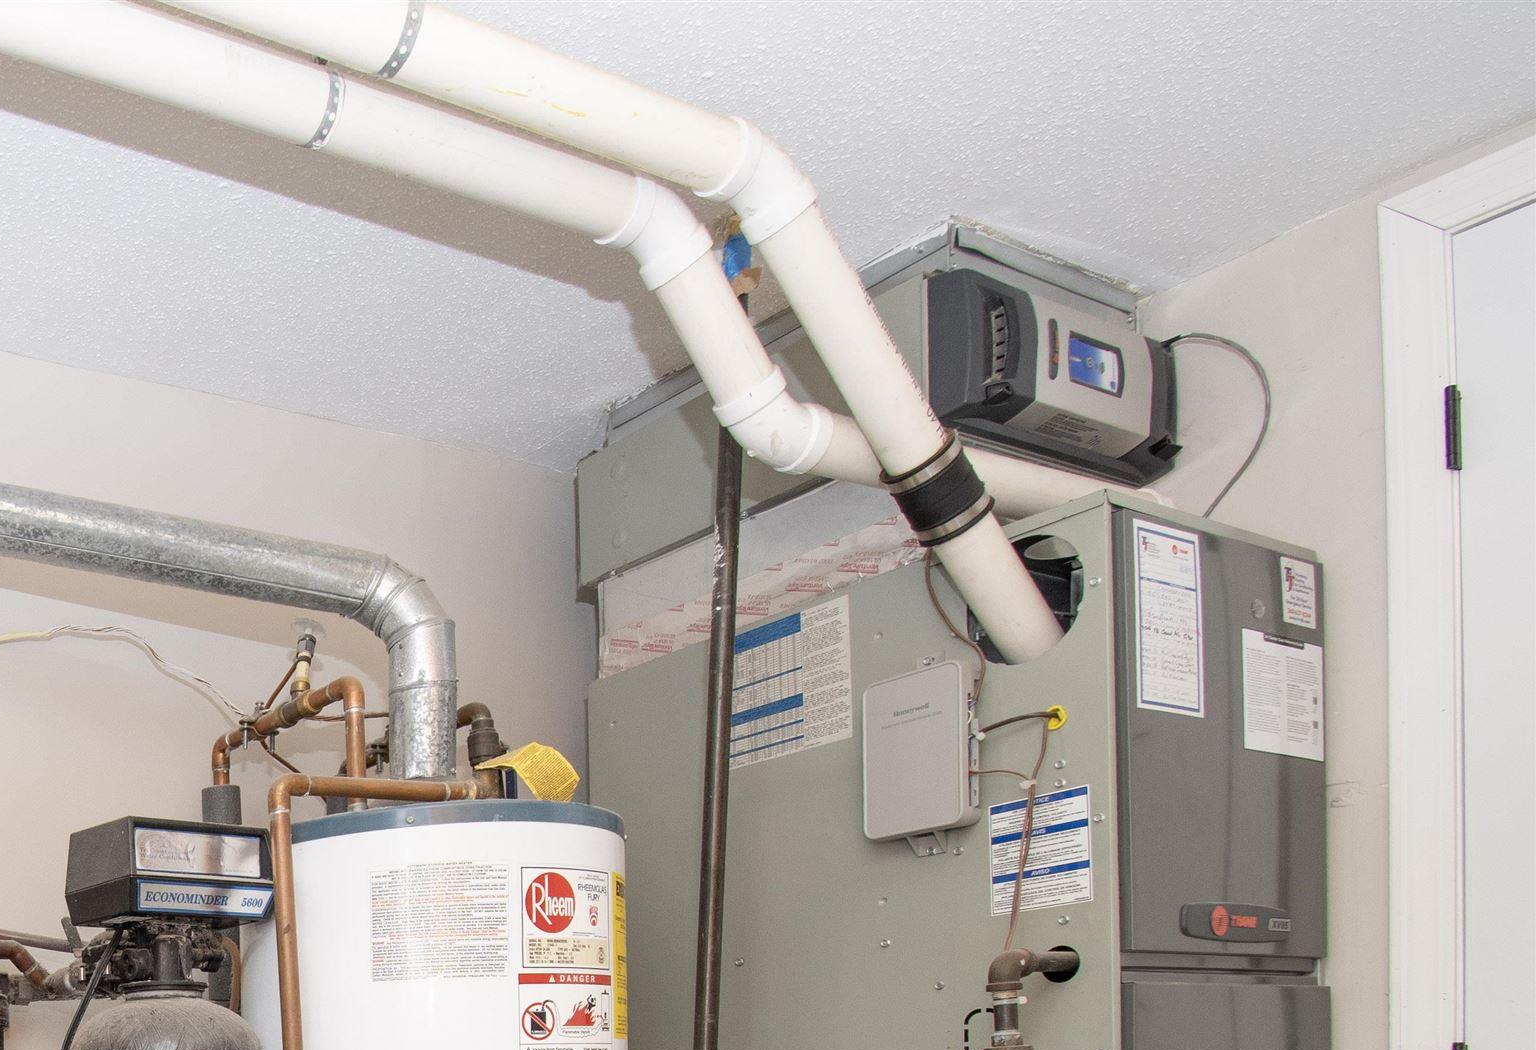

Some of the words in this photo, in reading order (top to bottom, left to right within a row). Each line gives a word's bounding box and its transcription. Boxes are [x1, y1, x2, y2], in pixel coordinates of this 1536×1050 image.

[893, 702, 930, 718] Honeywell
[1031, 868, 1050, 876] AVISO
[144, 890, 229, 907] ECONOMINDER
[241, 897, 264, 909] 5600
[531, 874, 574, 926] Rheem
[587, 893, 600, 902] FURY
[559, 975, 596, 984] DANGER
